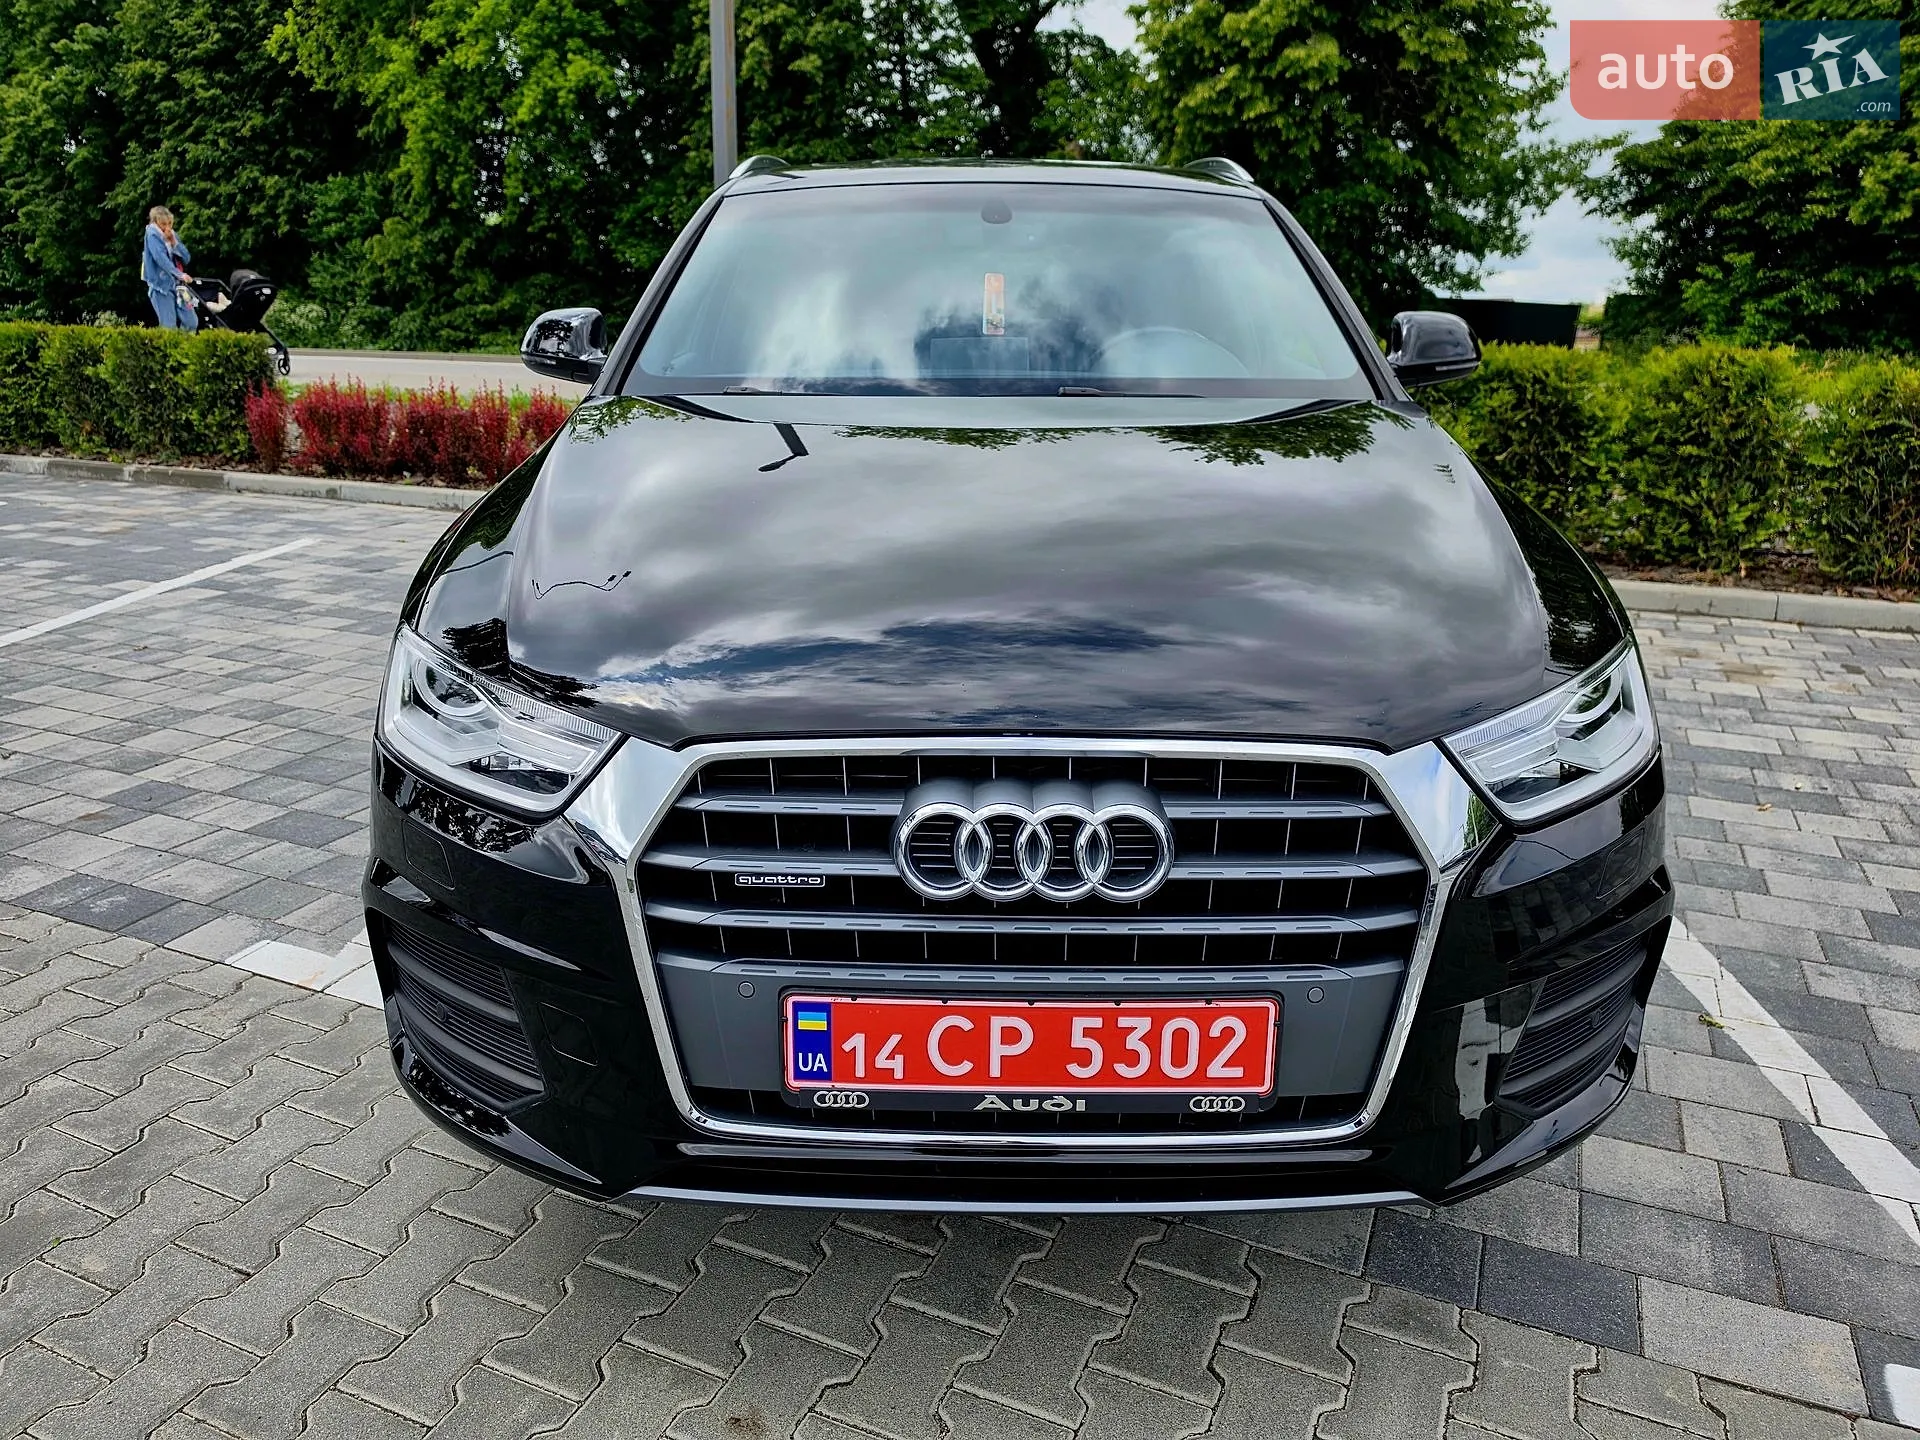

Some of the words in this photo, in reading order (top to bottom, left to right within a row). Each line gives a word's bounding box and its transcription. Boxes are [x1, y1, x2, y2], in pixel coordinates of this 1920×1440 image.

[738, 875, 821, 885] quattro
[841, 1032, 904, 1080] 14
[926, 1014, 1035, 1078] CP
[1065, 1015, 1247, 1080] 5302
[798, 1052, 828, 1073] UA
[973, 1095, 1087, 1113] Audi
